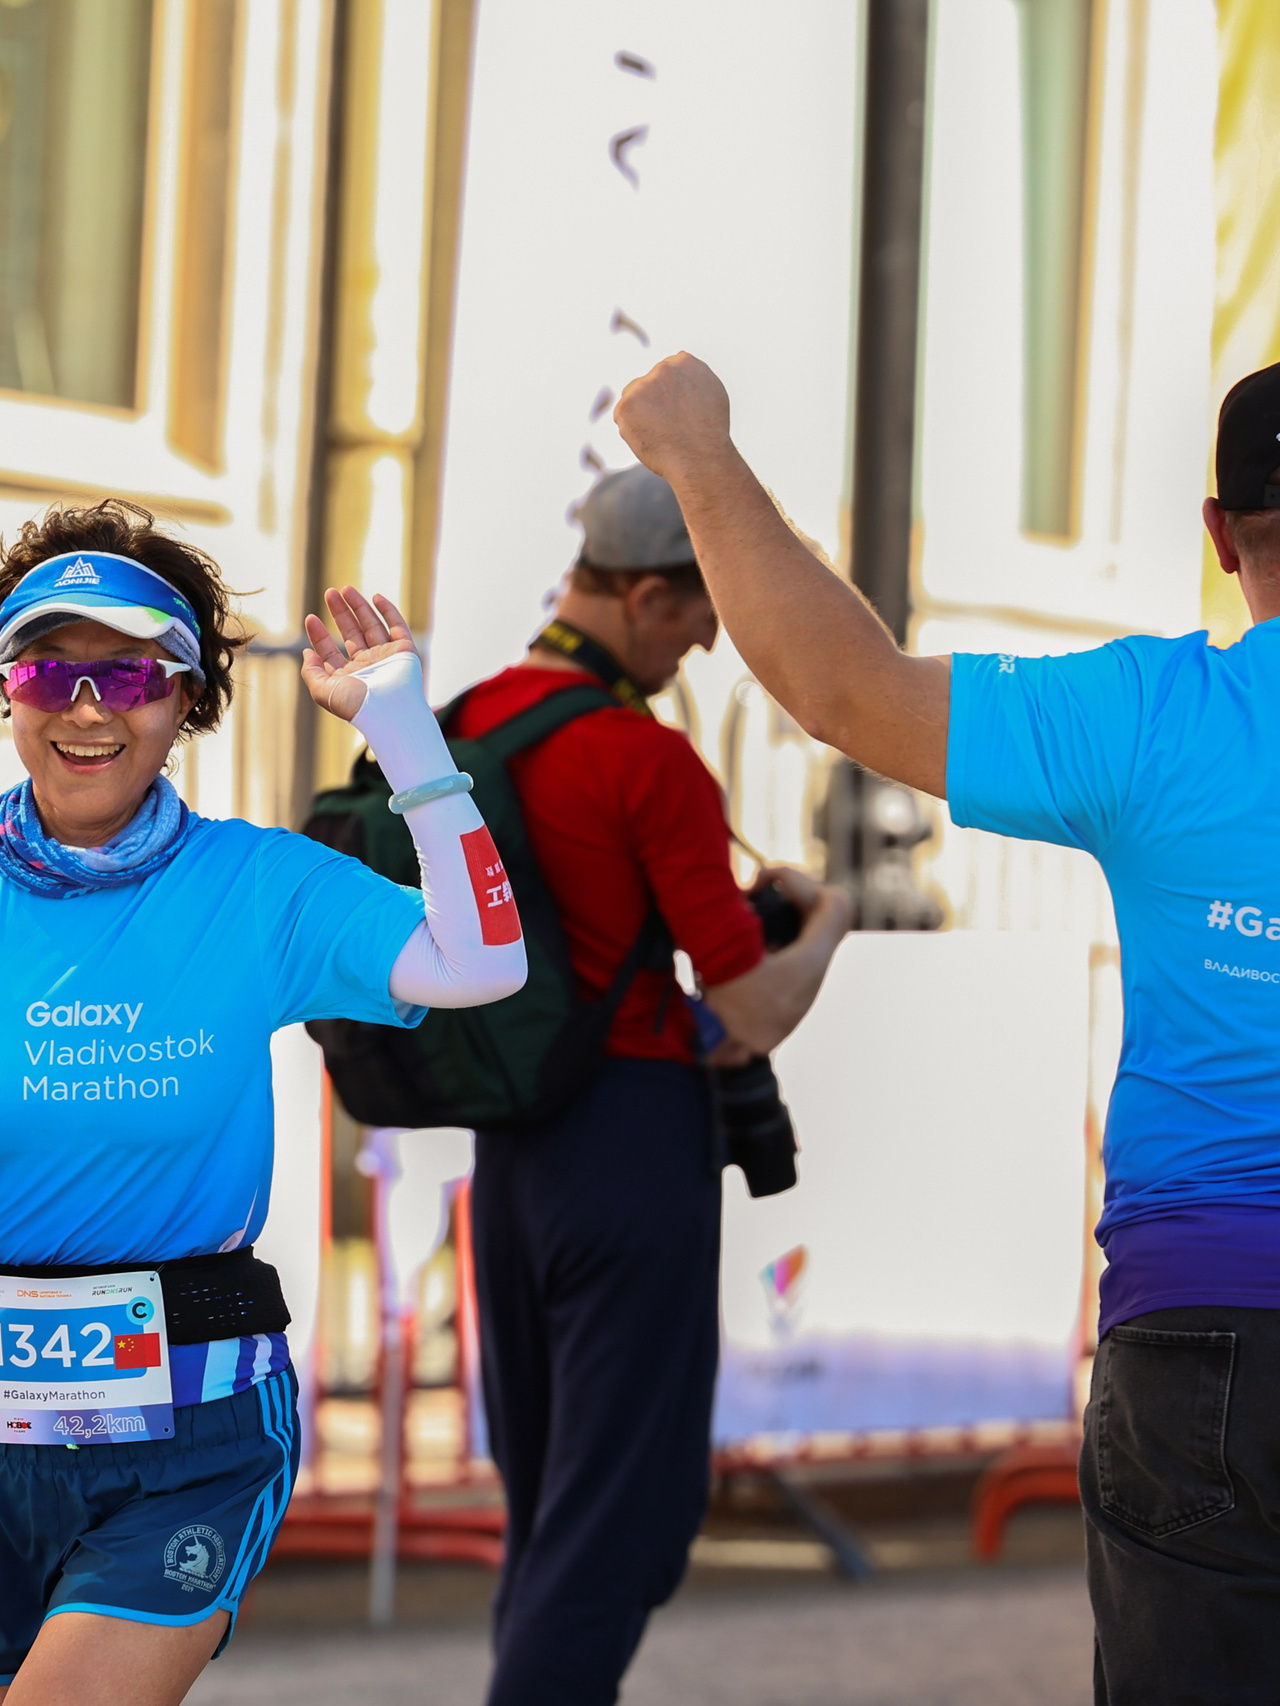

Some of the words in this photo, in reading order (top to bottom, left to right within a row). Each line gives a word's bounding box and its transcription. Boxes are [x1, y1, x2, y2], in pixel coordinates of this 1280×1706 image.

[54, 577, 101, 588] AONIJIE
[25, 1000, 144, 1033] Galaxy
[24, 1028, 216, 1067] Vladivostok
[22, 1073, 180, 1102] Marathon
[16, 1289, 39, 1298] DNS
[131, 1301, 148, 1320] C
[3, 1389, 106, 1402] #GalaxyMarathon
[52, 1413, 147, 1439] 42,2km
[179, 1527, 213, 1540] ATHLETIC
